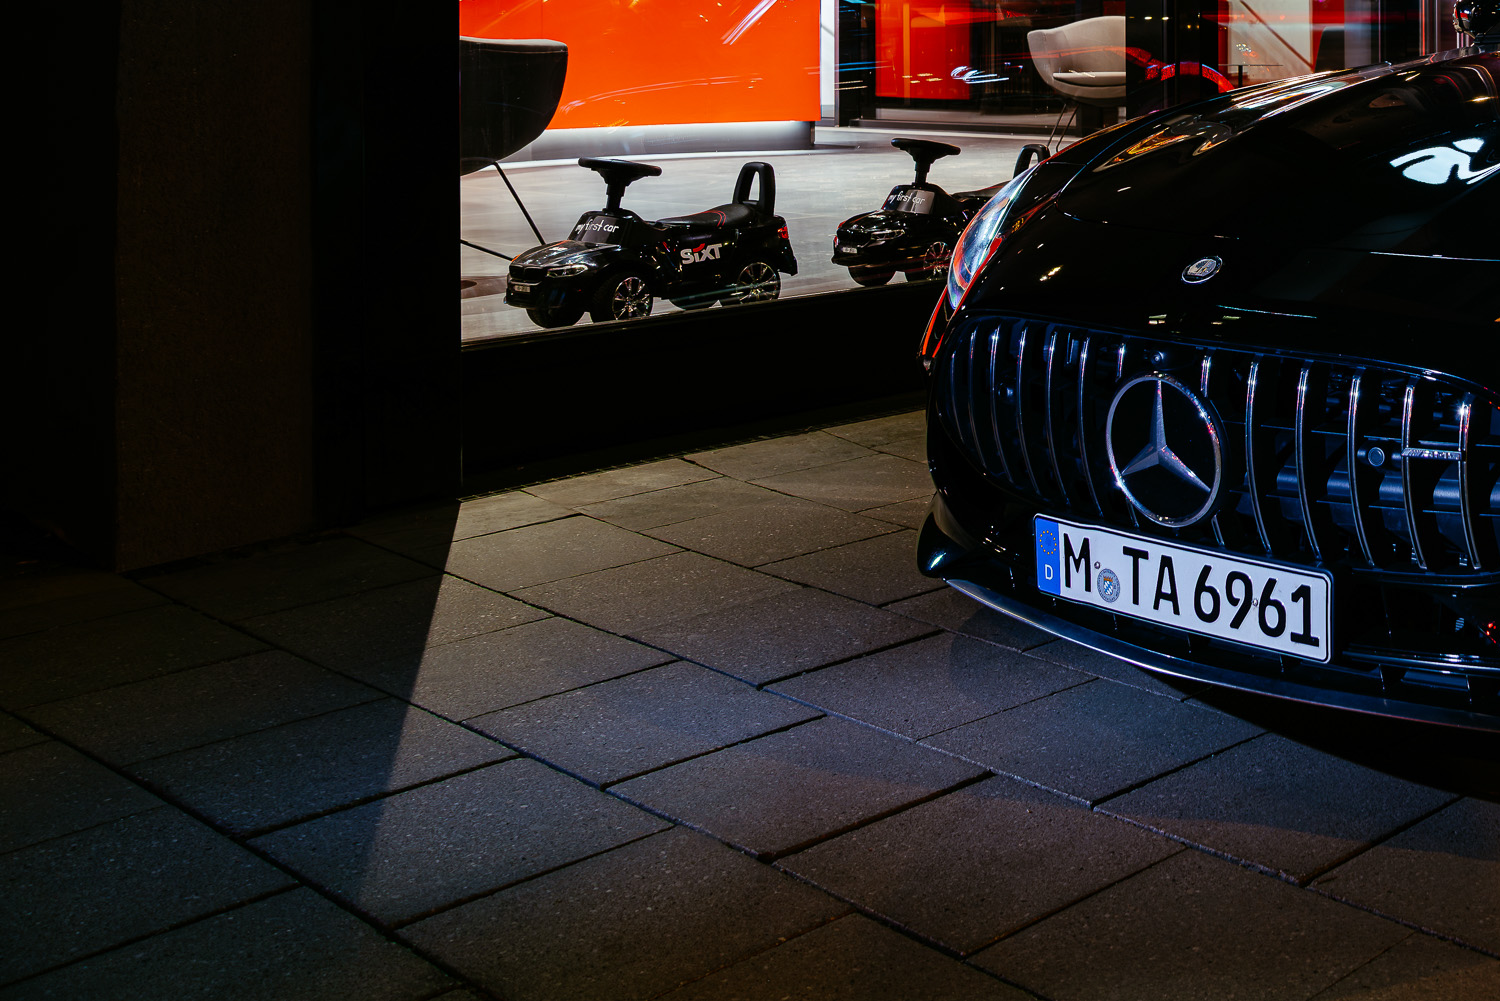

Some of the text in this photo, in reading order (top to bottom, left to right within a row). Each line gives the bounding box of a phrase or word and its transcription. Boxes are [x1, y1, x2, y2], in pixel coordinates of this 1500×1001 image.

[912, 196, 926, 205] car
[585, 218, 604, 232] first
[603, 225, 620, 233] car
[680, 243, 723, 265] SIXT
[1045, 564, 1053, 580] D
[1063, 533, 1091, 592] M
[1122, 546, 1181, 616] TA
[1194, 564, 1320, 648] 6961
